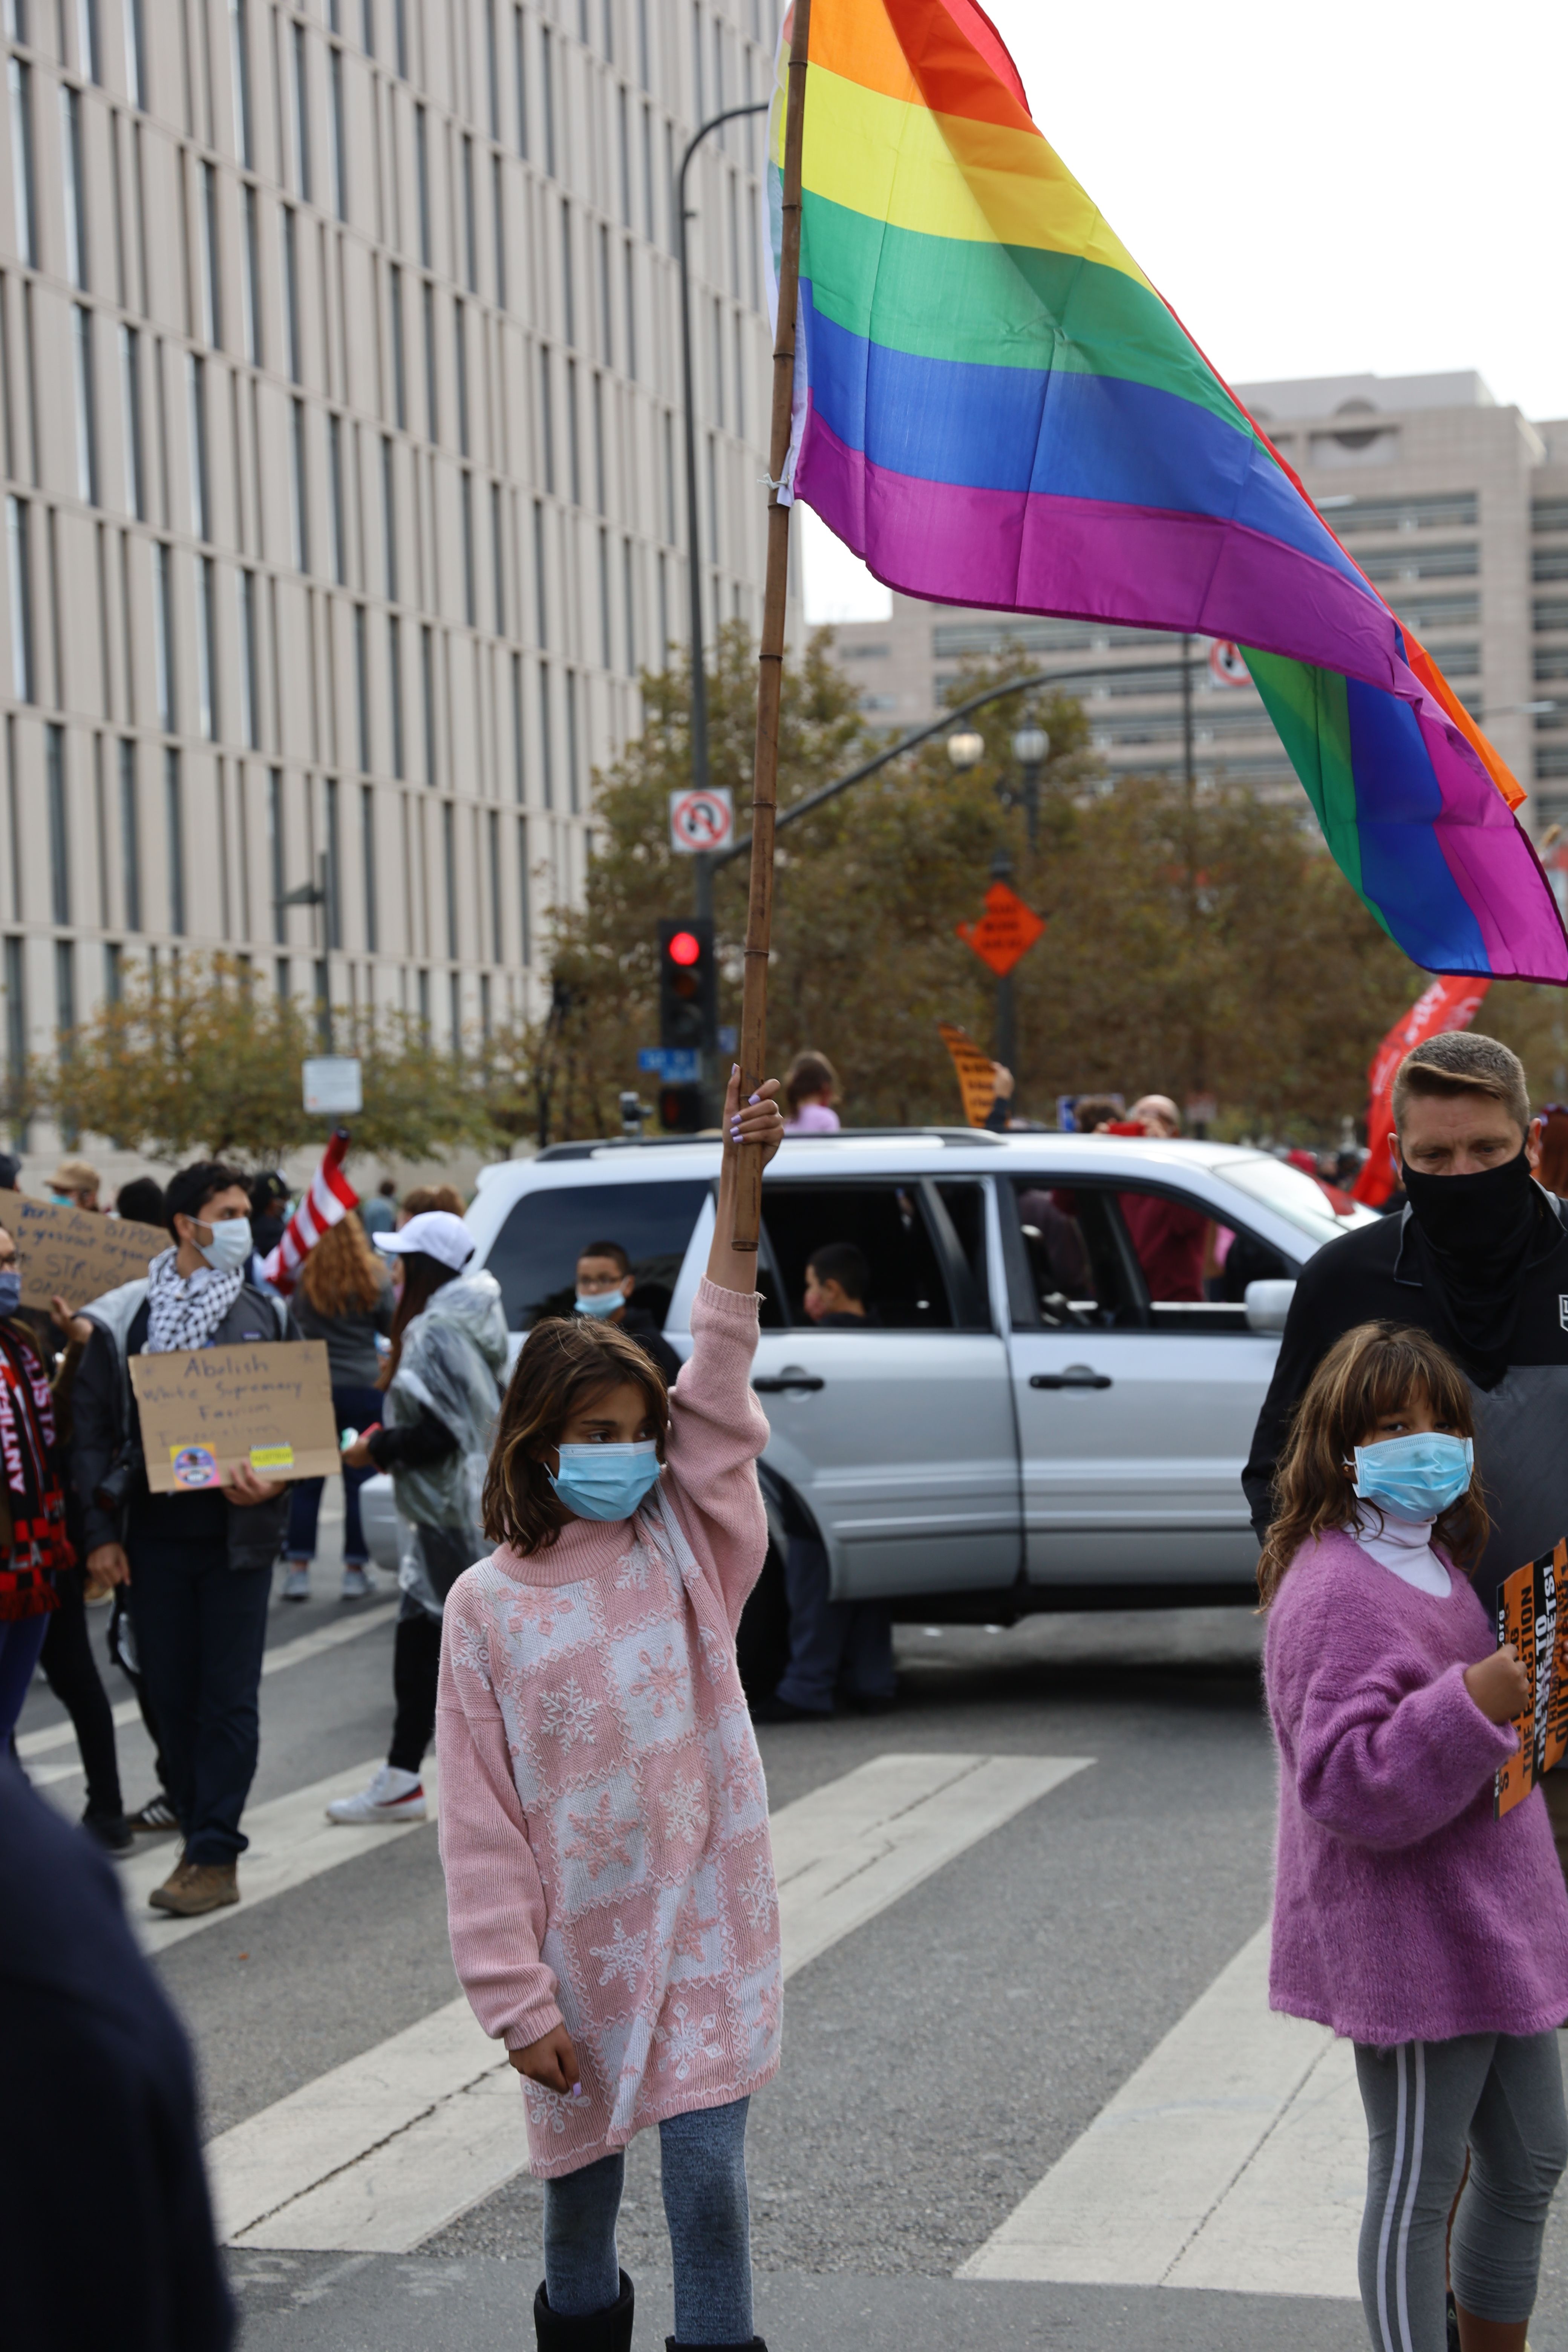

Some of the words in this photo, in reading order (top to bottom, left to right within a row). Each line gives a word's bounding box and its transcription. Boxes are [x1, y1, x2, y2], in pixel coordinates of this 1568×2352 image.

[183, 1354, 268, 1378] Abolish
[143, 1384, 198, 1402] White
[215, 1380, 302, 1399] Supremacy
[1535, 1614, 1547, 1657] TO
[1537, 1709, 1548, 1770] THE
[1543, 1564, 1556, 1703] STREETS!
[1534, 1662, 1545, 1741] TAKE
[1522, 1723, 1533, 1779] THE
